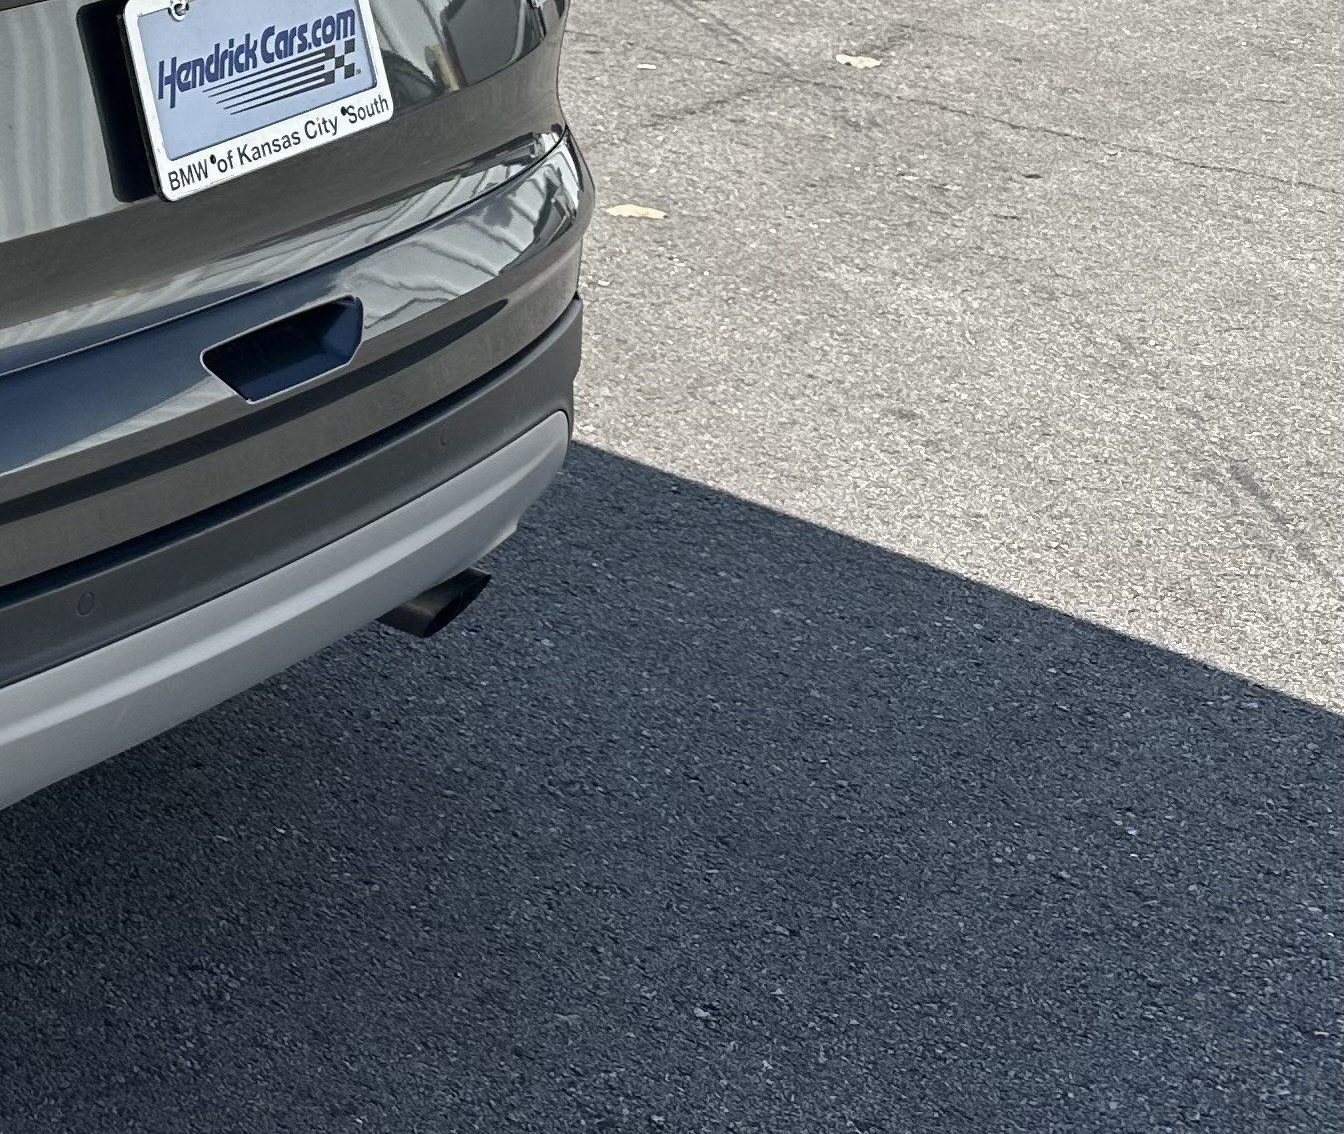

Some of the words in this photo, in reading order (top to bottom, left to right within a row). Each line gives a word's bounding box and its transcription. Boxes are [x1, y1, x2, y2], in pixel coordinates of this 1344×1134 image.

[167, 158, 210, 192] BMW
[217, 150, 234, 174] of
[238, 131, 302, 166] Kansas
[304, 115, 339, 141] City
[346, 95, 390, 124] South
